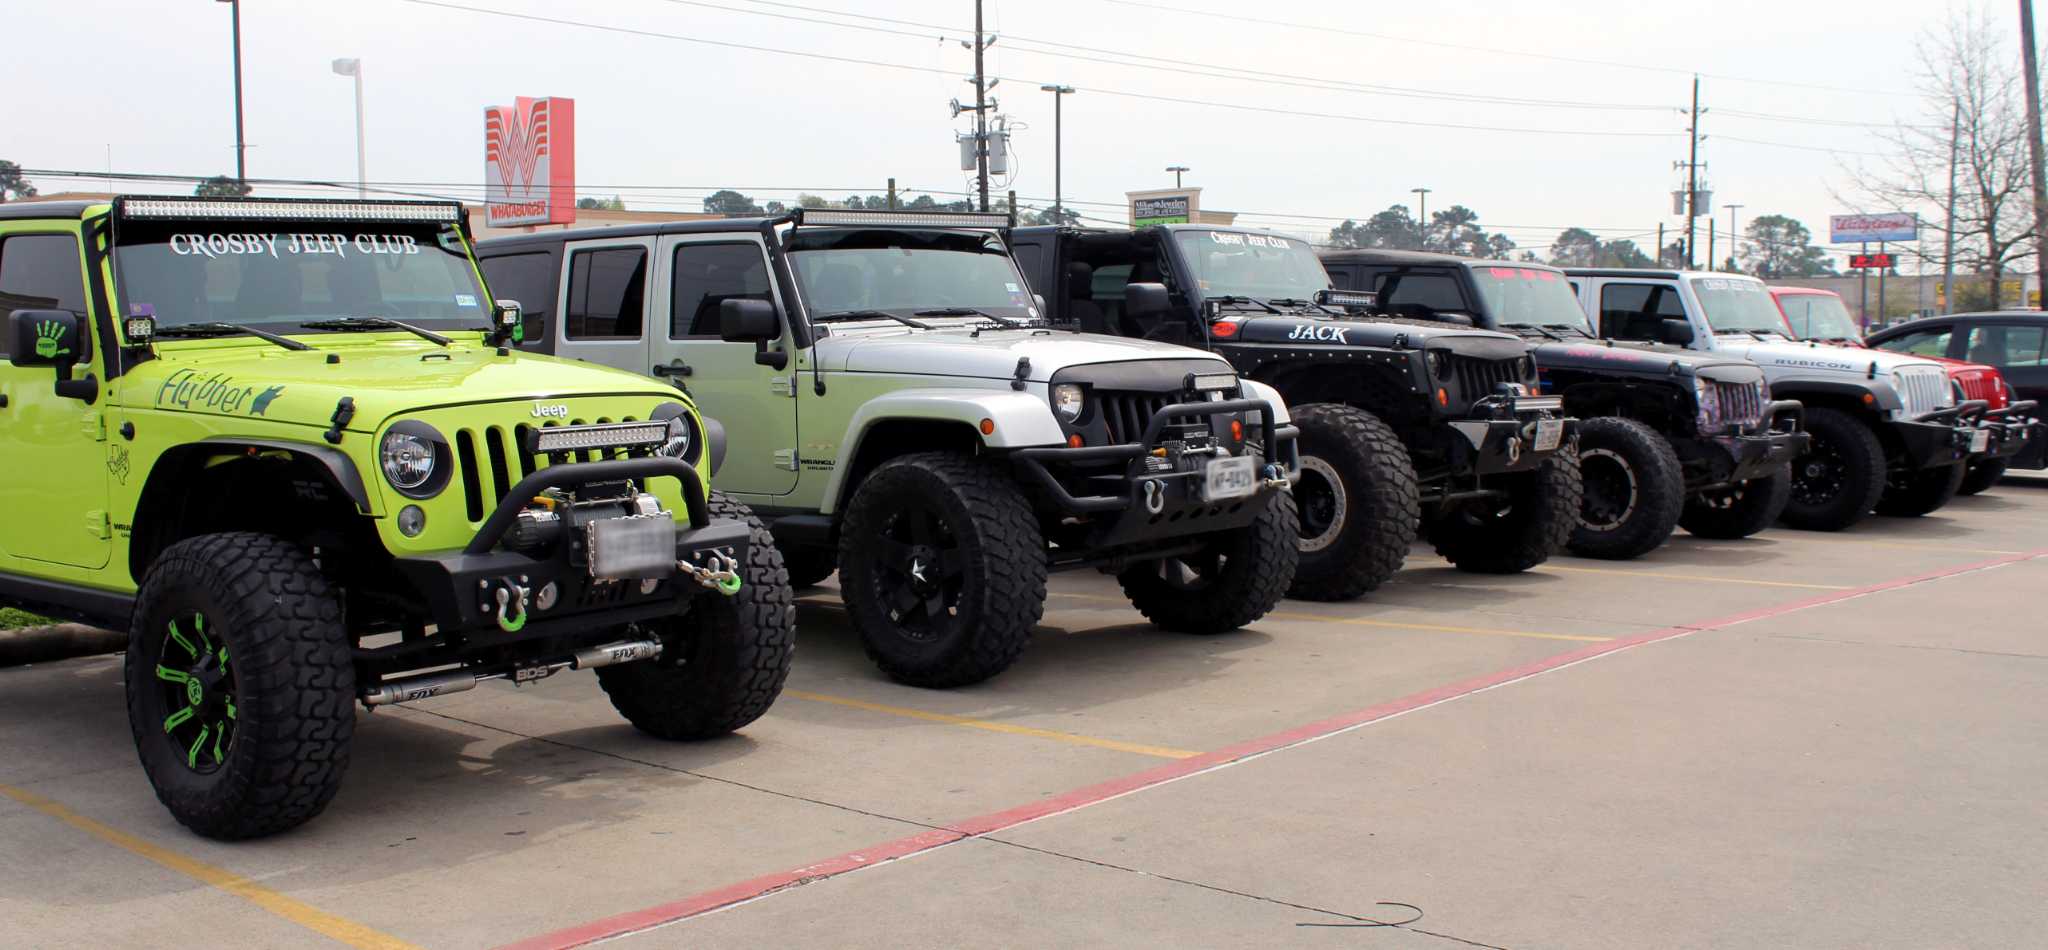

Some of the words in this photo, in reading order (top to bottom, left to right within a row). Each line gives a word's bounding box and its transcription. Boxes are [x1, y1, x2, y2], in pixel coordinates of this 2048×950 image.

[490, 200, 546, 219] WHATABURGER
[170, 233, 279, 259] CROSBY
[288, 233, 347, 258] JEEP
[354, 234, 419, 255] CLUB
[1288, 325, 1350, 345] JACK
[1775, 359, 1852, 370] RUBICON
[531, 403, 569, 418] Jeep
[516, 666, 549, 681] BDS
